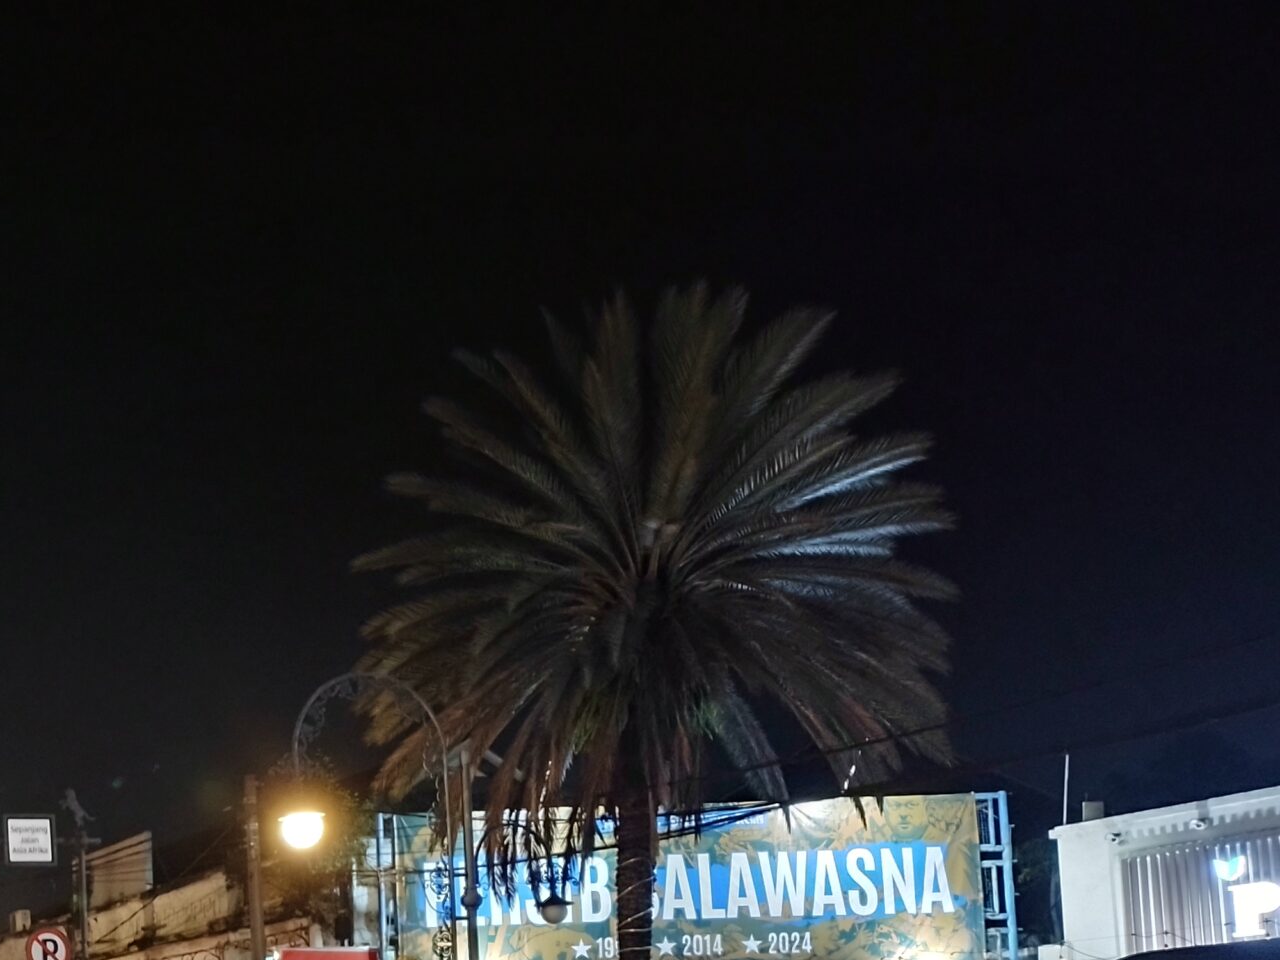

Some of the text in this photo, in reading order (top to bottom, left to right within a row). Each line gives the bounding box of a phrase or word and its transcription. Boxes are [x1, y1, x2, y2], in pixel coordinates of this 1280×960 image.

[10, 825, 48, 835] Sepanjang
[682, 934, 723, 956] 2014
[768, 931, 812, 954] 2024
